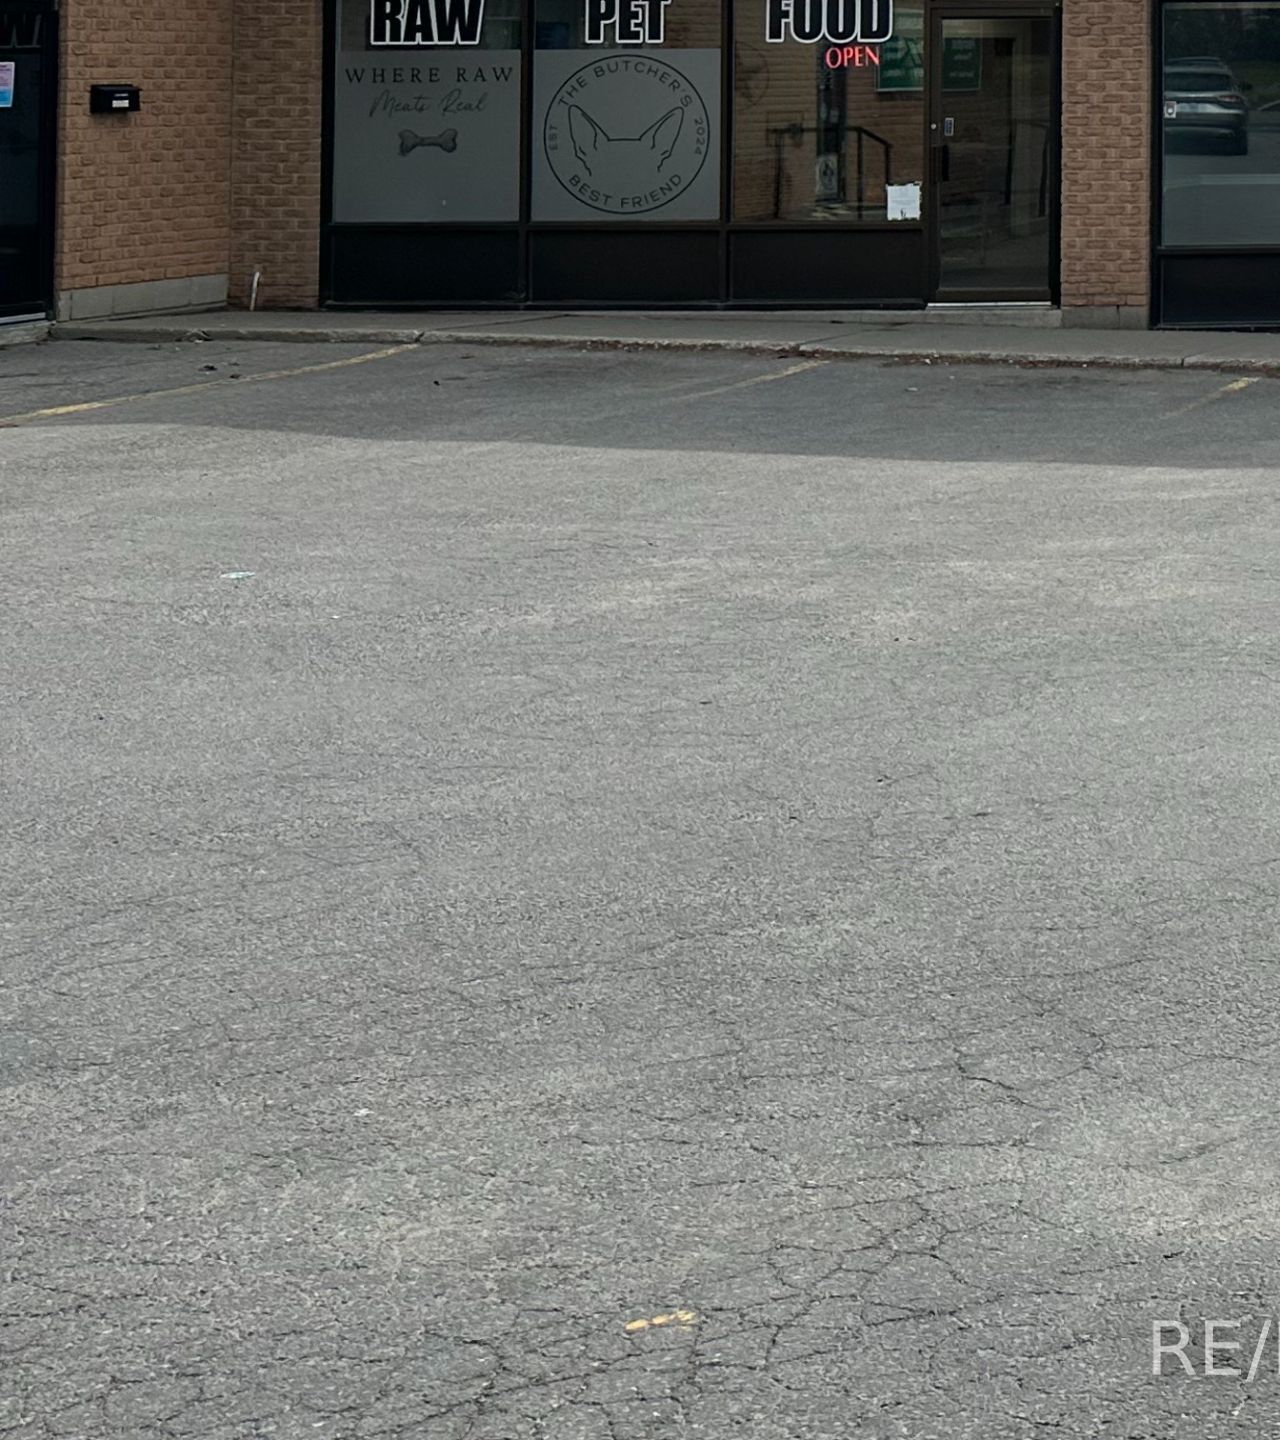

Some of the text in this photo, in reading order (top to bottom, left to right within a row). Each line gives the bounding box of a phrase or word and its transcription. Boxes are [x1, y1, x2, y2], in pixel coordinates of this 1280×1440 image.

[826, 46, 880, 69] OPEN
[345, 66, 513, 84] WHERE RAW
[558, 60, 693, 108] THE BUTCHER'S
[440, 88, 489, 117] Real
[568, 174, 682, 208] BEST FRIEND
